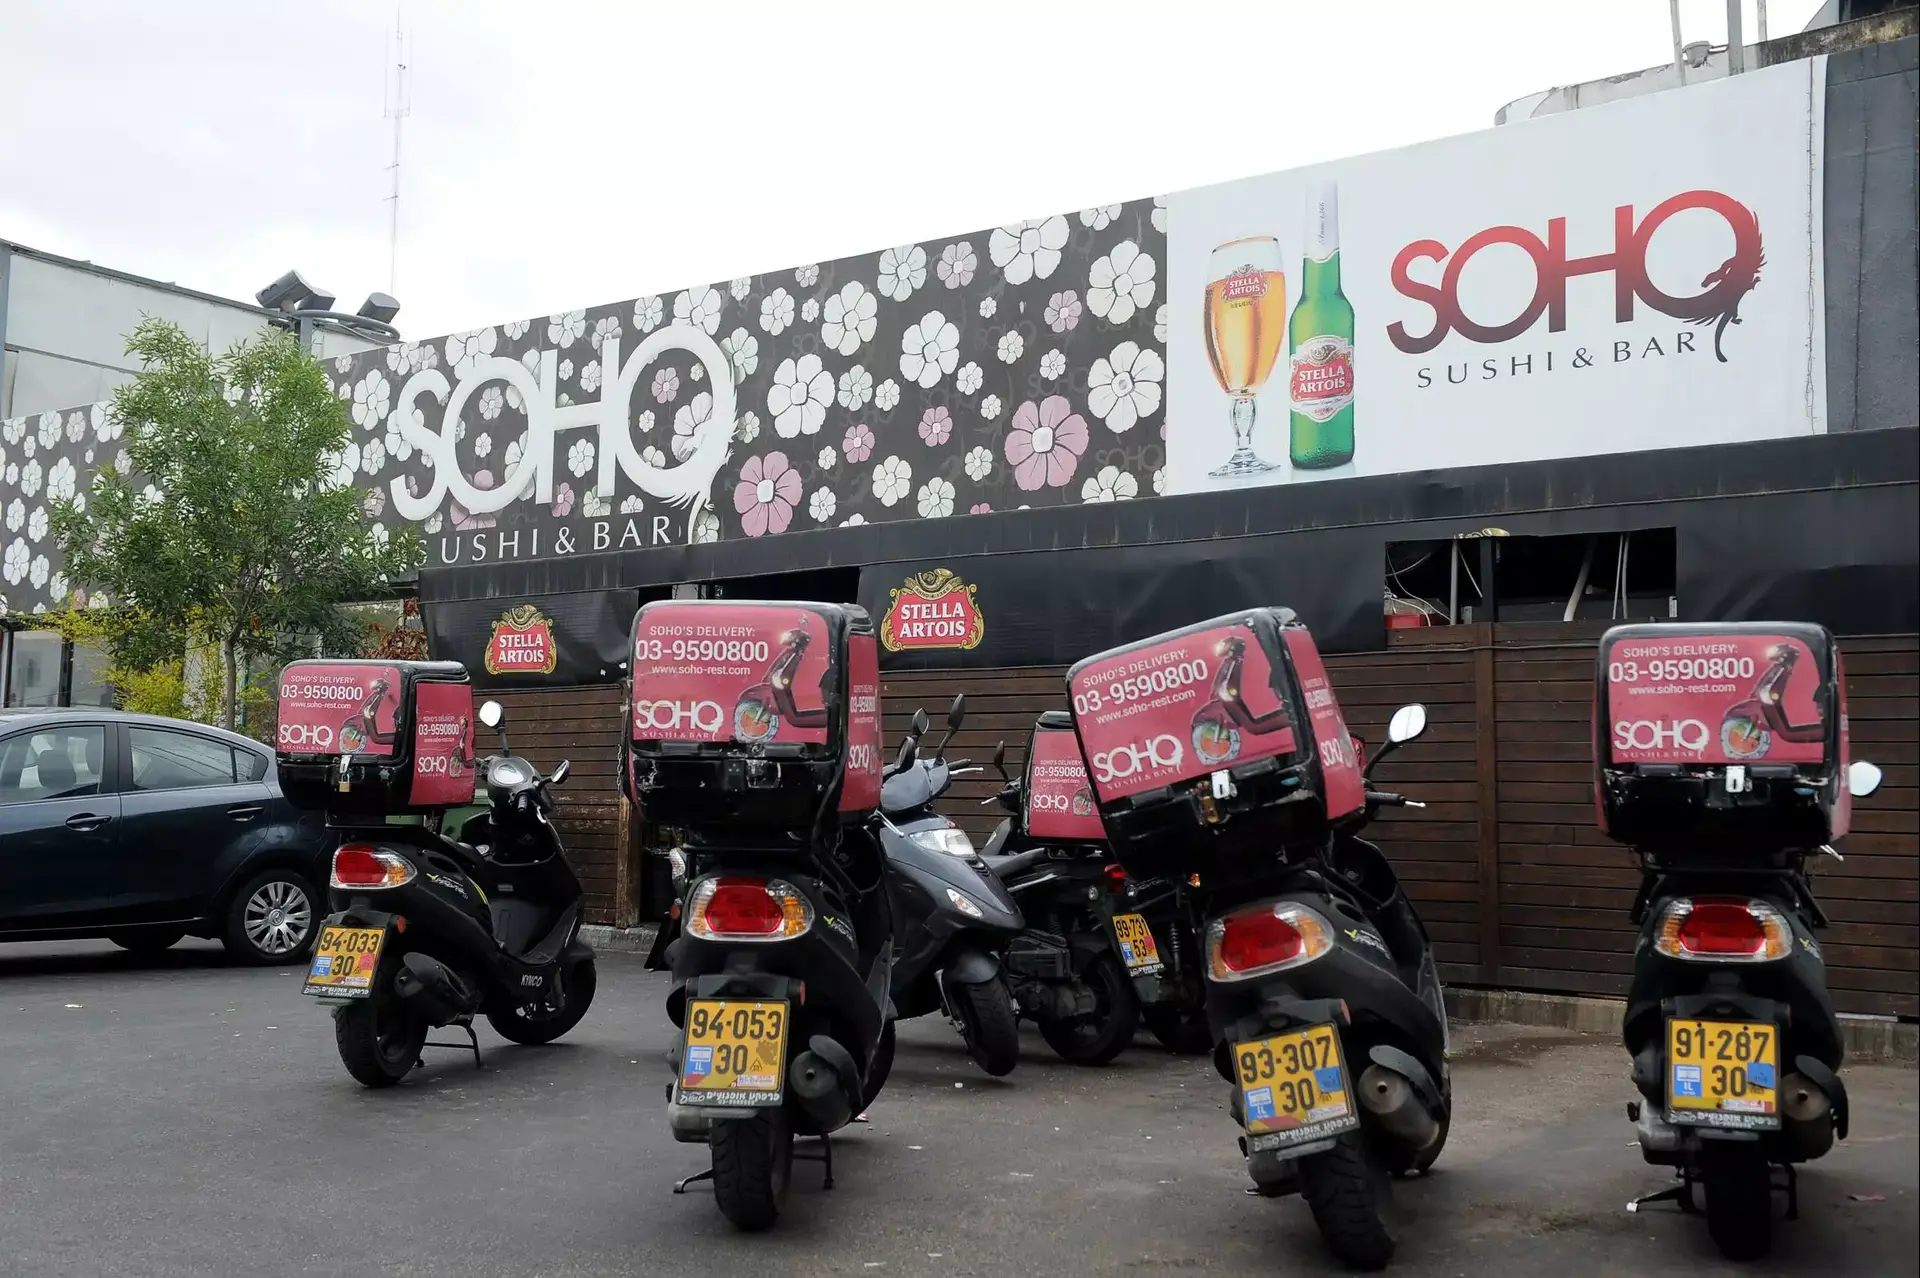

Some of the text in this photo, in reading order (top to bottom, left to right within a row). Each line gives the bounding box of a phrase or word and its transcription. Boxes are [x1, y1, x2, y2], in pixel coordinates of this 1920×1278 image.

[1230, 277, 1260, 289] STELLA
[1387, 190, 1765, 355] SOHO
[1229, 285, 1261, 296] ARTOIS
[1417, 331, 1696, 389] SUSHI & BAR
[1299, 365, 1345, 382] STELLA
[1299, 376, 1346, 393] ARTOIS
[390, 324, 738, 521] SOHO
[554, 526, 576, 555] &
[593, 515, 672, 551] BAR
[900, 602, 965, 620] STELLA
[499, 633, 544, 648] STELLA
[650, 626, 756, 637] SOHO'S DELIVERY:
[899, 621, 966, 638] ARTOIS
[498, 649, 545, 663] ARTOIS
[635, 639, 769, 662] 03-9590800
[1623, 644, 1739, 658] SOHO'S DELIVERY:
[290, 675, 356, 684] SOHO'S DELIVERY:
[651, 664, 751, 675] www.soho-rest.com
[1083, 649, 1189, 688] SOHO'S DELIVERY:
[1609, 657, 1755, 682] 03-9590800
[281, 684, 363, 700] 03-9590800
[1073, 659, 1209, 716] 03-9590800
[1628, 683, 1736, 695] www.soho-rest.com
[635, 699, 724, 733] SOHO
[1096, 689, 1196, 725] www.soho-rest.com
[279, 724, 333, 746] SOHO
[419, 724, 459, 735] 03-9590800
[689, 731, 709, 739] BAR
[1613, 719, 1710, 751] SOHO
[417, 756, 447, 773] SOHO
[848, 744, 870, 769] SOHO
[1092, 734, 1184, 783] SOHO
[1153, 767, 1175, 779] BAR
[1033, 794, 1068, 810] SOHO
[1133, 939, 1147, 958] 53
[332, 954, 355, 976] 30
[692, 1008, 782, 1041] 94-053
[1675, 1027, 1770, 1063] 91-287
[715, 1044, 748, 1076] 30
[1240, 1035, 1332, 1084] 93-307
[1711, 1064, 1746, 1097] 30
[1279, 1077, 1316, 1113] 30
